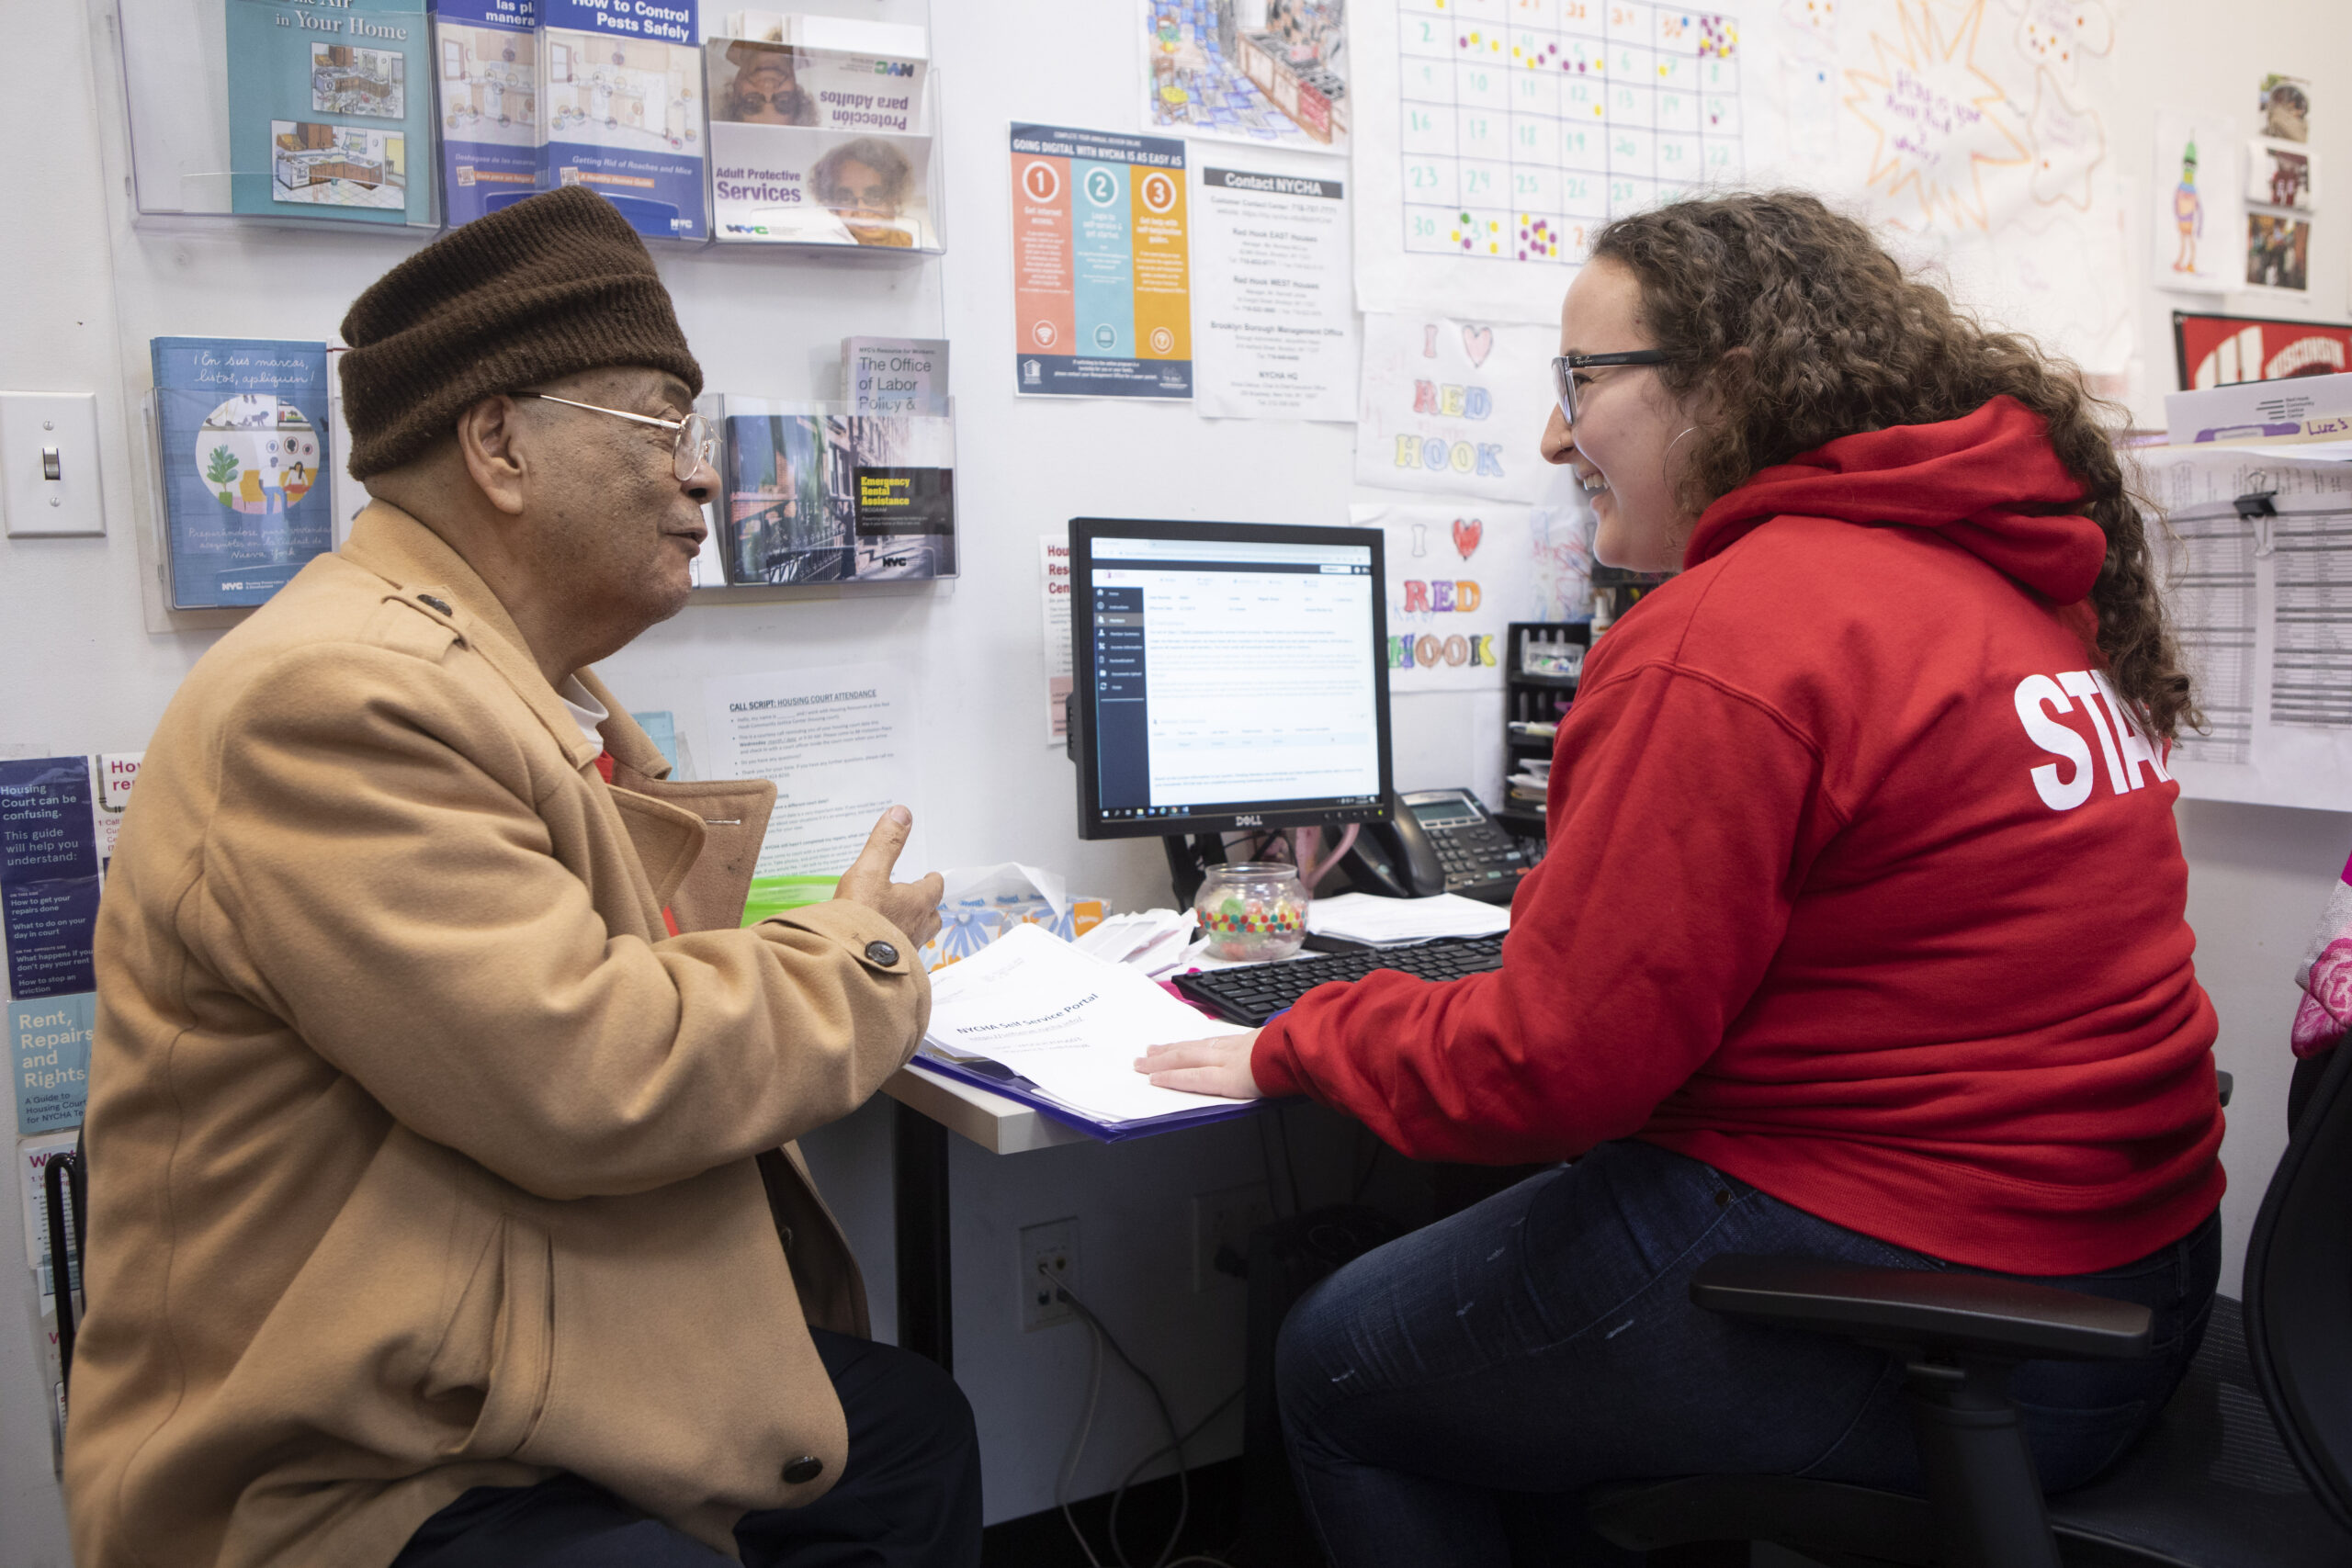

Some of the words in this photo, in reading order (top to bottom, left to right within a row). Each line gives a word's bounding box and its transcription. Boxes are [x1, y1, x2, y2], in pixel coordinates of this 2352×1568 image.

[496, 0, 515, 13] las
[614, 0, 630, 13] to
[634, 4, 690, 24] Control
[276, 13, 290, 27] in
[295, 10, 344, 33] Your
[349, 17, 408, 40] Home
[597, 12, 639, 32] Pests
[643, 22, 690, 43] Safely
[1419, 22, 1434, 42] 2
[874, 61, 915, 78] NYC
[1470, 71, 1488, 92] 10
[820, 90, 874, 109] Adultos
[876, 96, 909, 110] para
[832, 109, 908, 130] Protección
[1411, 110, 1432, 131] 16
[1013, 139, 1040, 152] GOING
[1042, 141, 1075, 155] DIGITAL
[1076, 145, 1096, 158] WITH
[1098, 147, 1125, 160] NYCHA
[1126, 151, 1136, 162] IS
[1136, 152, 1148, 163] AS
[1149, 153, 1170, 165] EASY
[1170, 155, 1182, 166] AS
[572, 155, 603, 167] Getting
[604, 157, 617, 167] Rid
[618, 160, 627, 168] of
[660, 165, 674, 174] and
[675, 165, 694, 175] Mice
[716, 167, 745, 179] Adult
[747, 169, 801, 181] Protective
[1035, 170, 1045, 193] 1
[1095, 175, 1108, 197] 2
[1225, 172, 1274, 191] Contact
[1275, 177, 1323, 196] NYCHA
[1410, 165, 1439, 188] 23
[1464, 169, 1491, 194] 24
[1515, 174, 1539, 195] 25
[717, 181, 801, 203] Services
[1153, 182, 1166, 204] 3
[1413, 215, 1435, 237] 30
[1422, 324, 1439, 359] I
[225, 355, 250, 367] sus
[254, 359, 309, 370] marcas,
[859, 356, 886, 371] The
[890, 357, 932, 372] Office
[194, 367, 239, 386] listos,
[859, 377, 874, 390] of
[877, 377, 919, 390] Labor
[859, 396, 901, 412] Policy
[906, 397, 916, 411] &
[1413, 378, 1493, 421] RED
[2306, 417, 2349, 436] Luz's
[1395, 433, 1505, 478] HOOK
[861, 476, 910, 488] Emergency
[861, 486, 890, 495] Rental
[861, 496, 910, 506] Assistance
[882, 558, 907, 567] NYC
[222, 582, 243, 591] NYC
[1403, 580, 1482, 613] RED
[1387, 632, 1498, 669] HOOK
[729, 702, 747, 713] CALL
[749, 699, 776, 711] SCRIPT:
[777, 696, 809, 708] HOUSING
[810, 693, 834, 705] COURT
[834, 689, 876, 702] ATTENDANCE
[2014, 669, 2174, 811] STA
[0, 784, 47, 795] Housing
[1, 797, 36, 808] Court
[39, 796, 60, 806] can
[62, 795, 77, 804] be
[3, 808, 62, 820] confusing.
[105, 818, 120, 826] Call
[1236, 815, 1262, 826] DELL
[4, 830, 28, 841] This
[32, 828, 64, 841] guide
[6, 842, 26, 853] will
[29, 841, 55, 852] help
[58, 840, 79, 852] you
[7, 852, 77, 866] understand:
[12, 908, 39, 916] repairs
[40, 905, 60, 913] done
[40, 897, 52, 906] get
[53, 896, 71, 905] your
[13, 922, 34, 931] What
[69, 918, 86, 926] your
[14, 931, 28, 940] day
[38, 928, 60, 936] court
[16, 953, 38, 963] What
[39, 951, 71, 961] happens
[79, 949, 94, 957] you
[17, 963, 38, 972] don't
[40, 962, 53, 970] pay
[54, 960, 73, 968] your
[74, 957, 90, 965] rent
[18, 978, 37, 987] How
[48, 975, 65, 983] stop
[18, 986, 51, 995] eviction
[19, 1010, 73, 1030] Rent,
[956, 1024, 999, 1035] NYCHA
[999, 1021, 1023, 1030] Self
[1023, 1010, 1065, 1026] Service
[1063, 992, 1099, 1013] Portal
[20, 1027, 94, 1050] Repairs
[22, 1049, 59, 1069] and
[24, 1066, 85, 1089] Rights
[26, 1104, 61, 1114] Housing
[62, 1100, 87, 1109] Court
[33, 1094, 59, 1103] Guide
[27, 1116, 40, 1124] for
[41, 1111, 73, 1122] NYCHA
